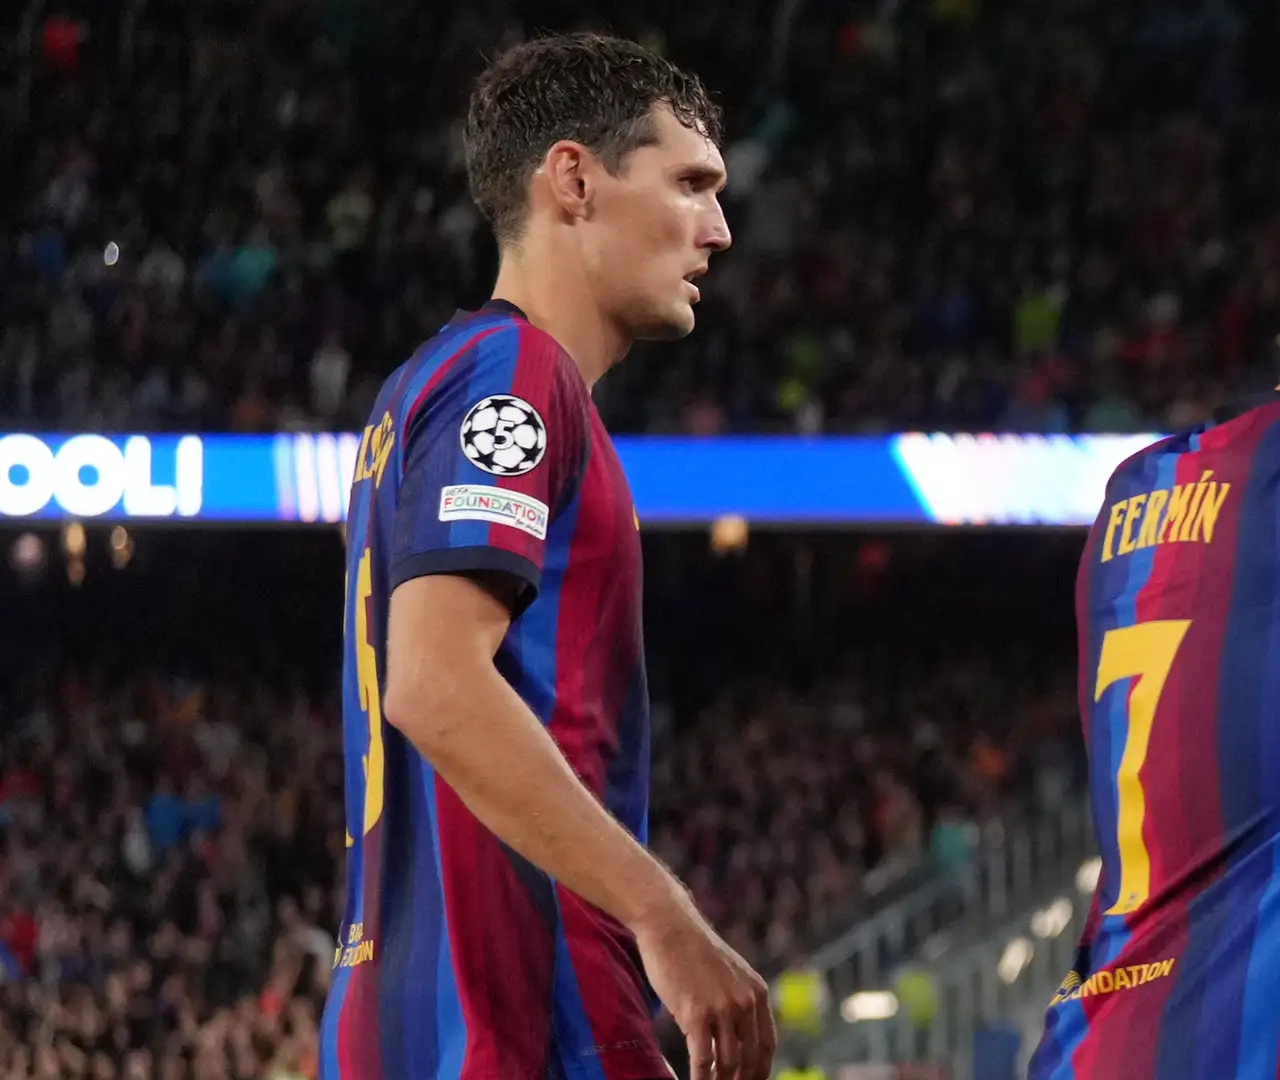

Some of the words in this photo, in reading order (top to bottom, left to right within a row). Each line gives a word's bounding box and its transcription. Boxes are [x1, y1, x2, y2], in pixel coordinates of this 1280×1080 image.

[493, 419, 515, 450] 5
[445, 487, 469, 496] UEFA
[444, 496, 545, 528] FOUNDATION
[1101, 470, 1231, 563] FERMÍN
[1095, 619, 1192, 916] 7
